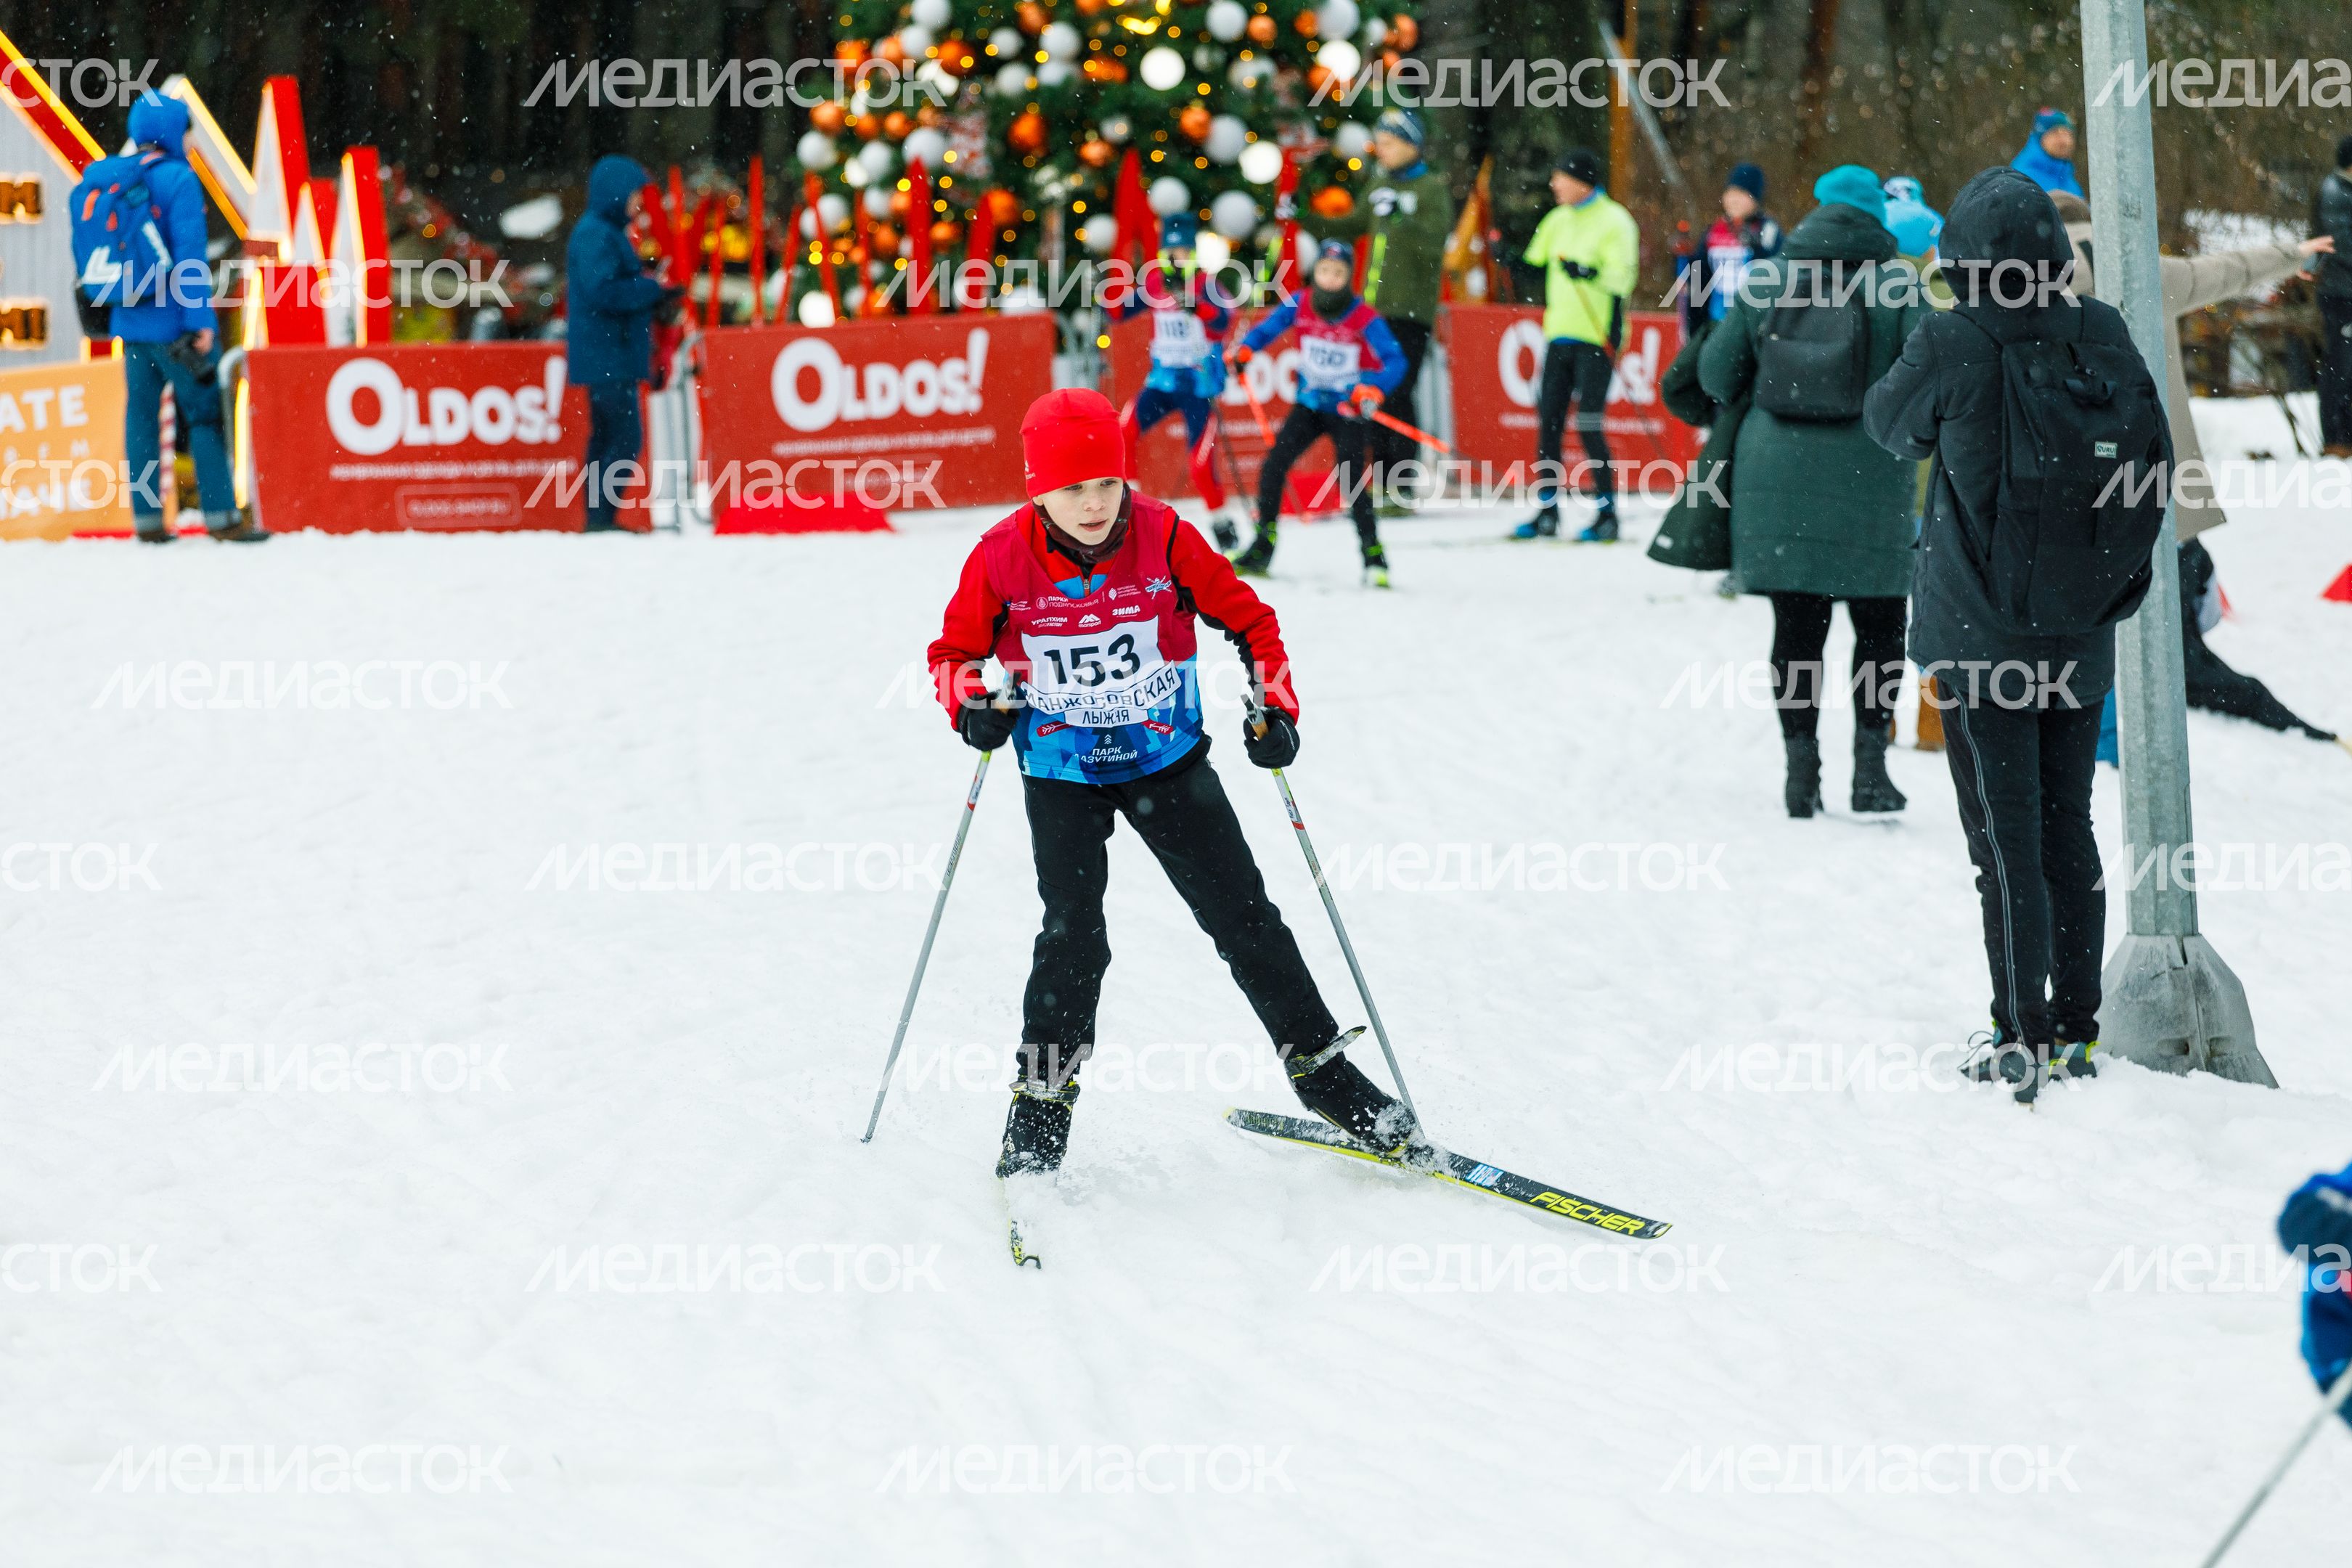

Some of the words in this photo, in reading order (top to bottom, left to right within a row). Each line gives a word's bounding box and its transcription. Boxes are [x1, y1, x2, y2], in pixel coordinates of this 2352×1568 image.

[1112, 604, 1141, 616] ЗИМА
[1031, 616, 1068, 626] УРАЛХИМ
[1044, 633, 1140, 687] 153
[1092, 746, 1122, 756] ПАРК
[1530, 1191, 1646, 1234] FISCHER
